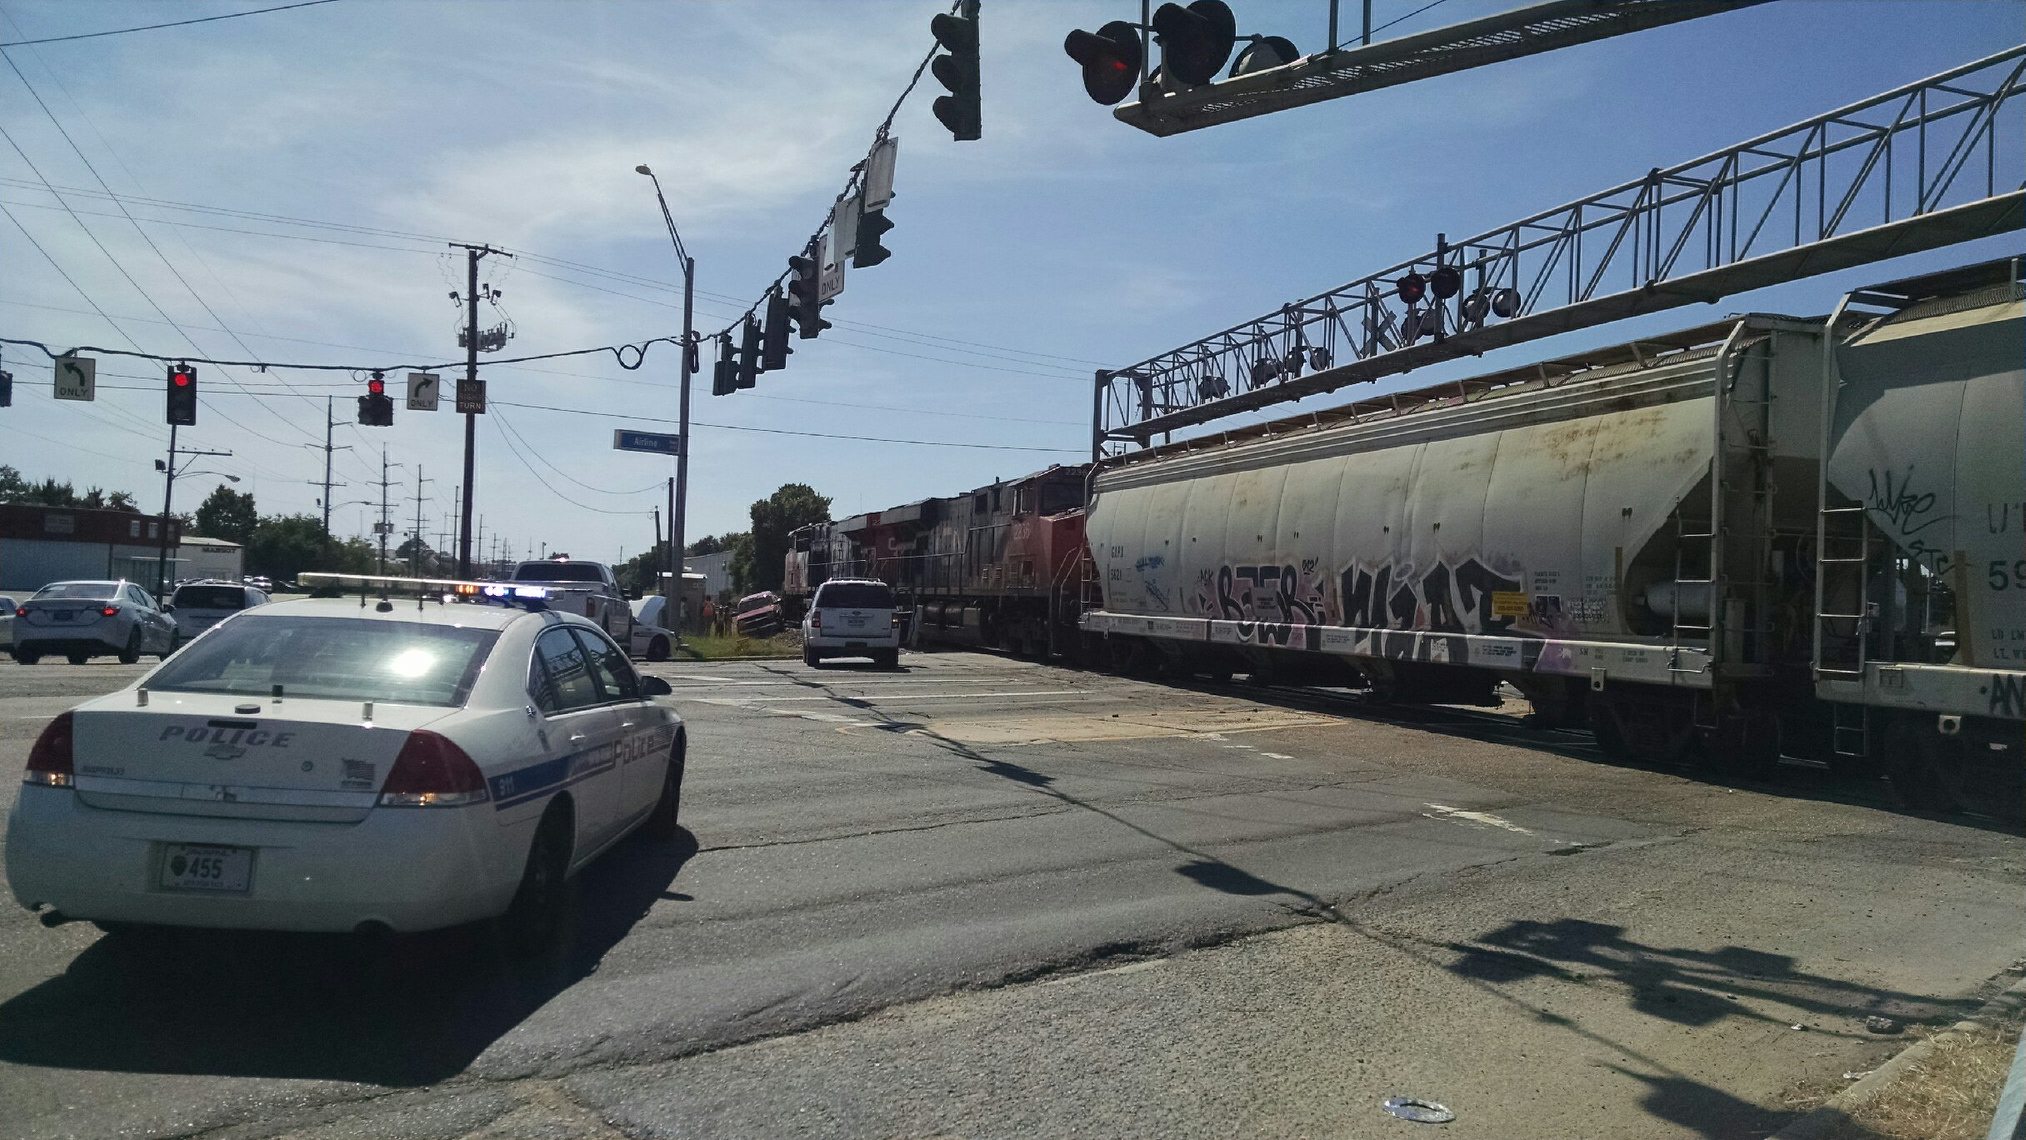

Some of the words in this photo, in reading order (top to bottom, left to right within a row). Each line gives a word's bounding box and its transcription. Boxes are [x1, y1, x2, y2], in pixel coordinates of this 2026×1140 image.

[821, 276, 840, 295] ONLY
[60, 387, 88, 397] ONLY
[410, 399, 434, 408] ONLY
[459, 402, 482, 410] TURN
[633, 436, 658, 448] Airline
[159, 725, 297, 749] POLICE
[188, 856, 223, 880] 455
